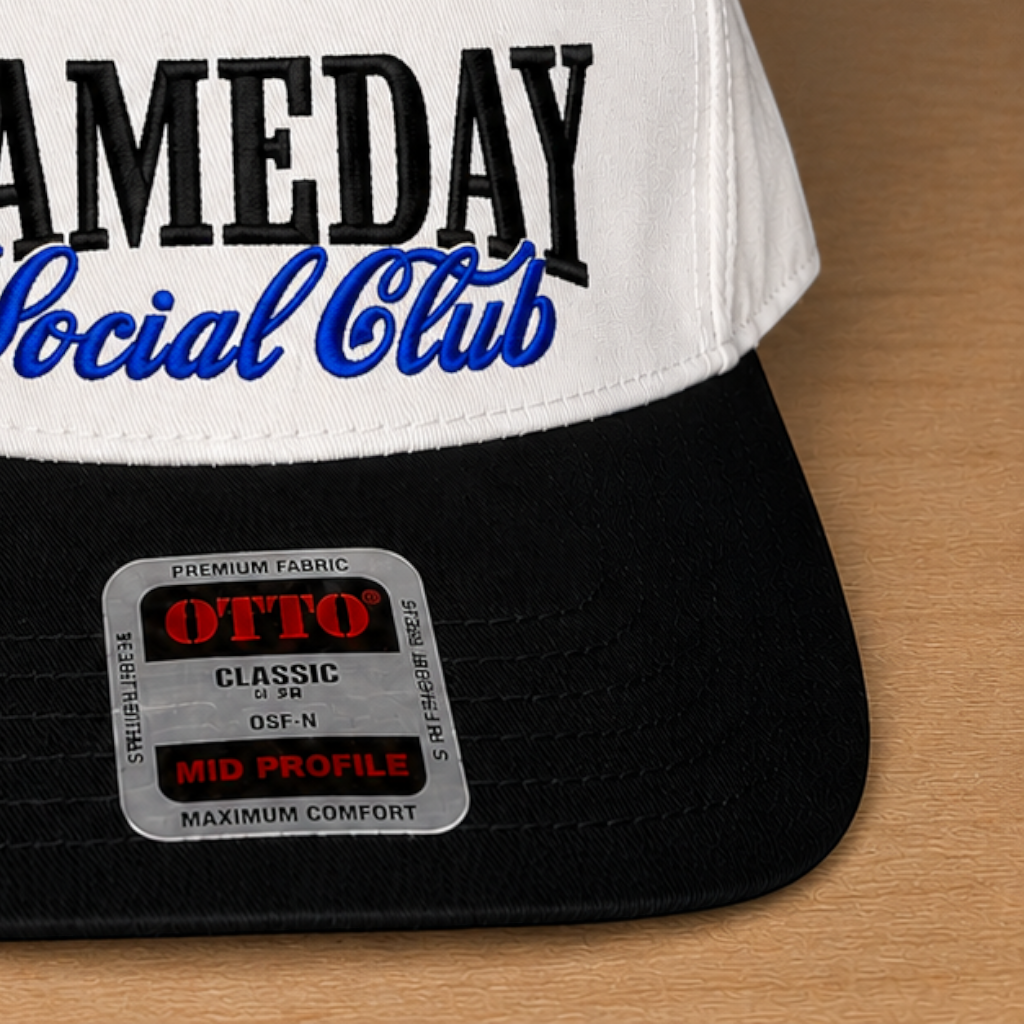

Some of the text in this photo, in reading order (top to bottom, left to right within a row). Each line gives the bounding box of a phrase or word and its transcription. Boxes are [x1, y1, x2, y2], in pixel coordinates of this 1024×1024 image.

[314, 239, 557, 379] Club
[171, 557, 350, 579] PREMIUM FABRIC
[214, 662, 340, 689] CLASSIC
[249, 712, 318, 731] OSF-N
[175, 752, 410, 785] MID PROFILE
[180, 804, 417, 828] MAXIMUM COMFORT
